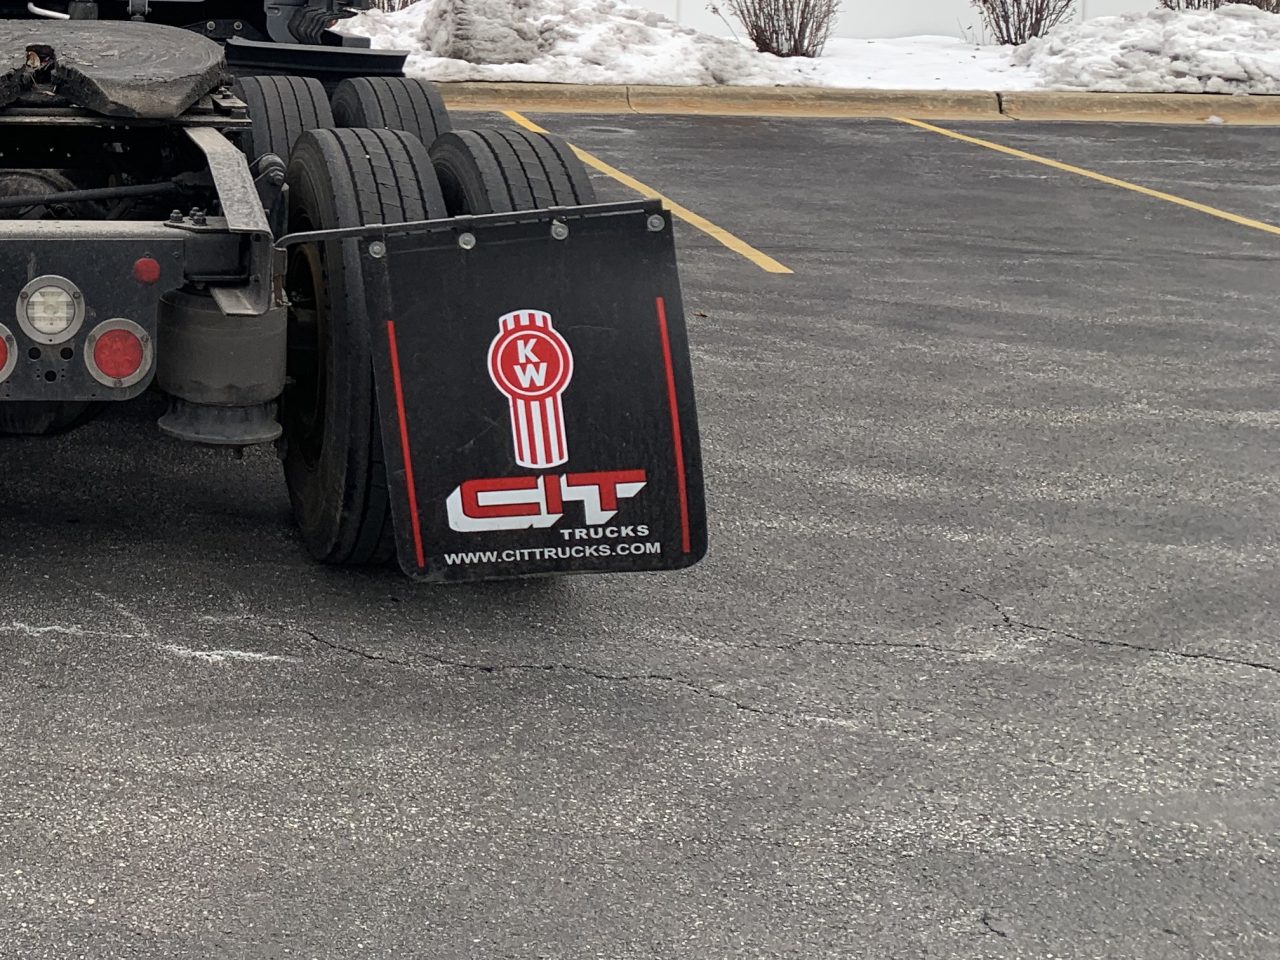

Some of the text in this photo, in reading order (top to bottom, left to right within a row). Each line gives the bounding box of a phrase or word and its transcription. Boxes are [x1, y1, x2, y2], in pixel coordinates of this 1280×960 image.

[446, 469, 648, 532] CIT
[559, 524, 650, 540] TRUCKS
[444, 542, 661, 566] WWW.CITTRUCKS.COM
